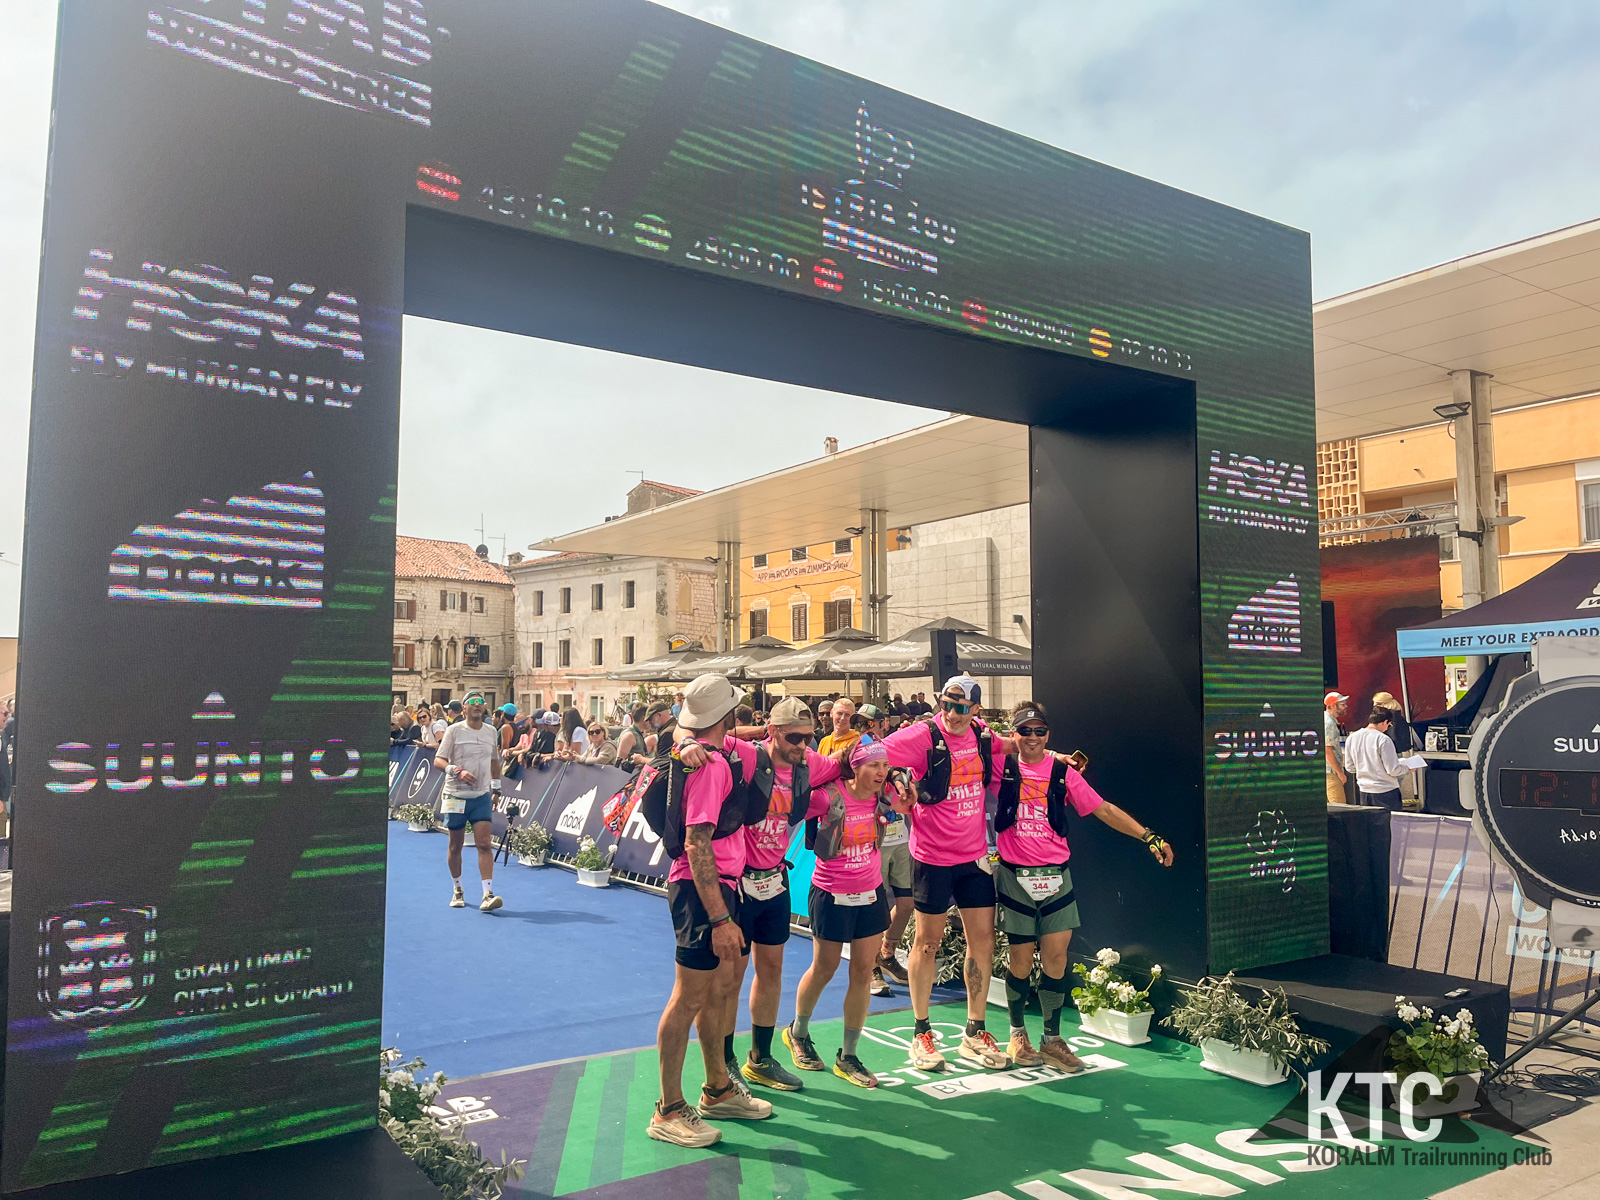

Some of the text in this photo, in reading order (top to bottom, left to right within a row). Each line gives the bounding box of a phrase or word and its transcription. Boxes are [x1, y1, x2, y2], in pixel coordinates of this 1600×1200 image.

[71, 249, 365, 361] HOKA
[1207, 449, 1312, 508] HOKA
[776, 567, 798, 579] ROOMS
[807, 562, 832, 574] ZIMMER
[1441, 636, 1474, 648] MEET
[1477, 633, 1516, 645] YOUR
[1214, 730, 1320, 758] SUUNTO
[45, 740, 360, 793] SUUNTO
[963, 801, 973, 809] DO
[1021, 822, 1034, 830] DO
[931, 1080, 972, 1095] BY
